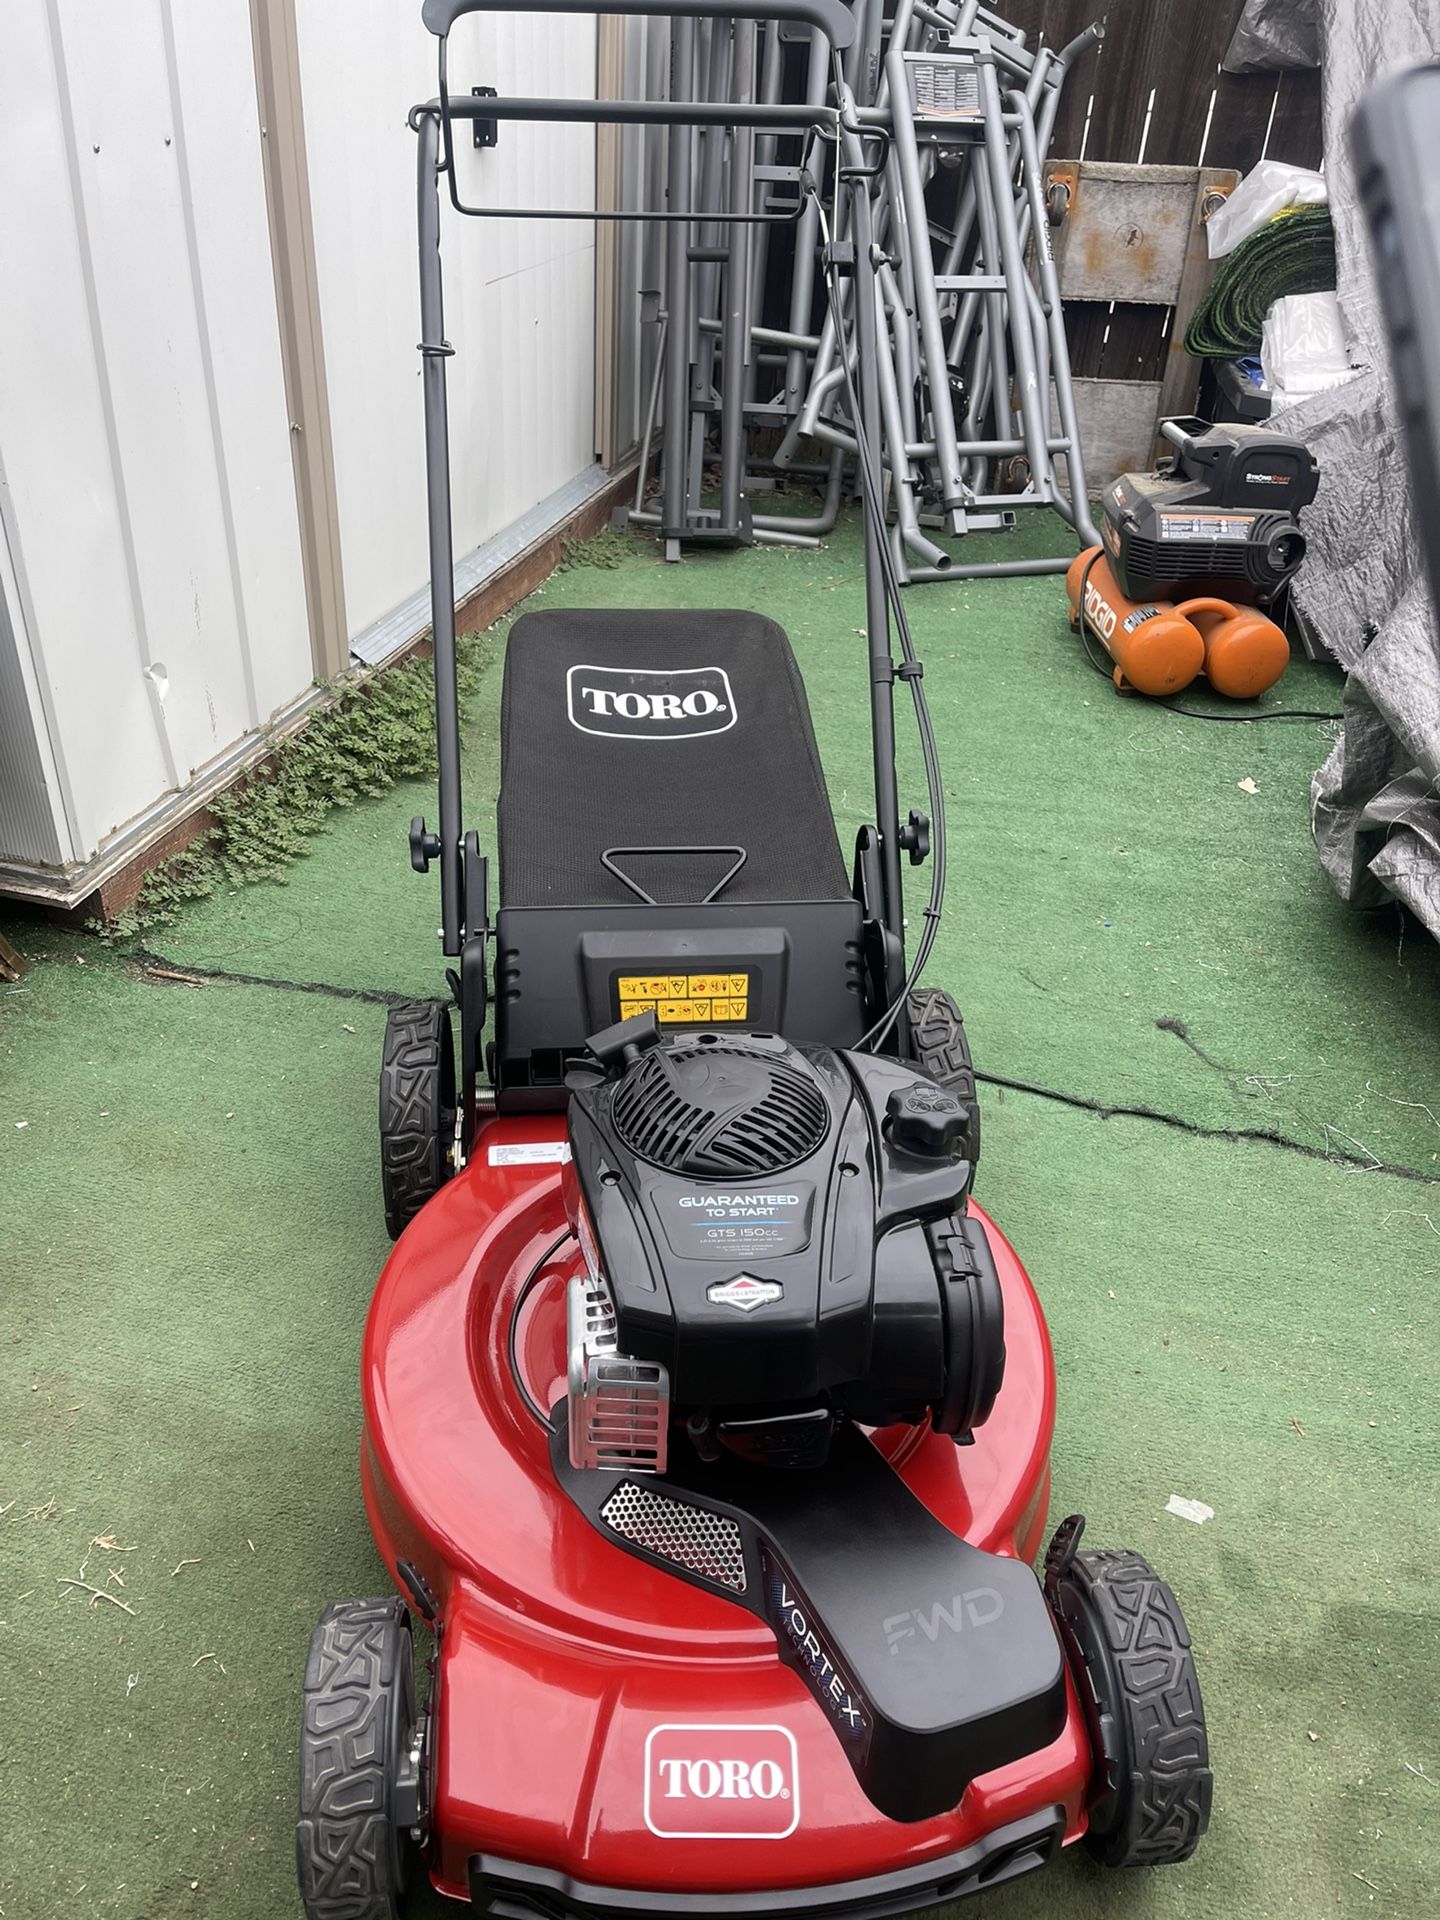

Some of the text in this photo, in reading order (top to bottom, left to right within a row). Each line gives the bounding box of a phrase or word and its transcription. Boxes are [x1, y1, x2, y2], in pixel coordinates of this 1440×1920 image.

[679, 1194, 800, 1208] GUARANTEED
[706, 1208, 726, 1217] TO
[707, 1228, 779, 1238] GTS 150cc
[882, 1587, 1005, 1656] FWD
[783, 1616, 844, 1719] TECHNOLOGY
